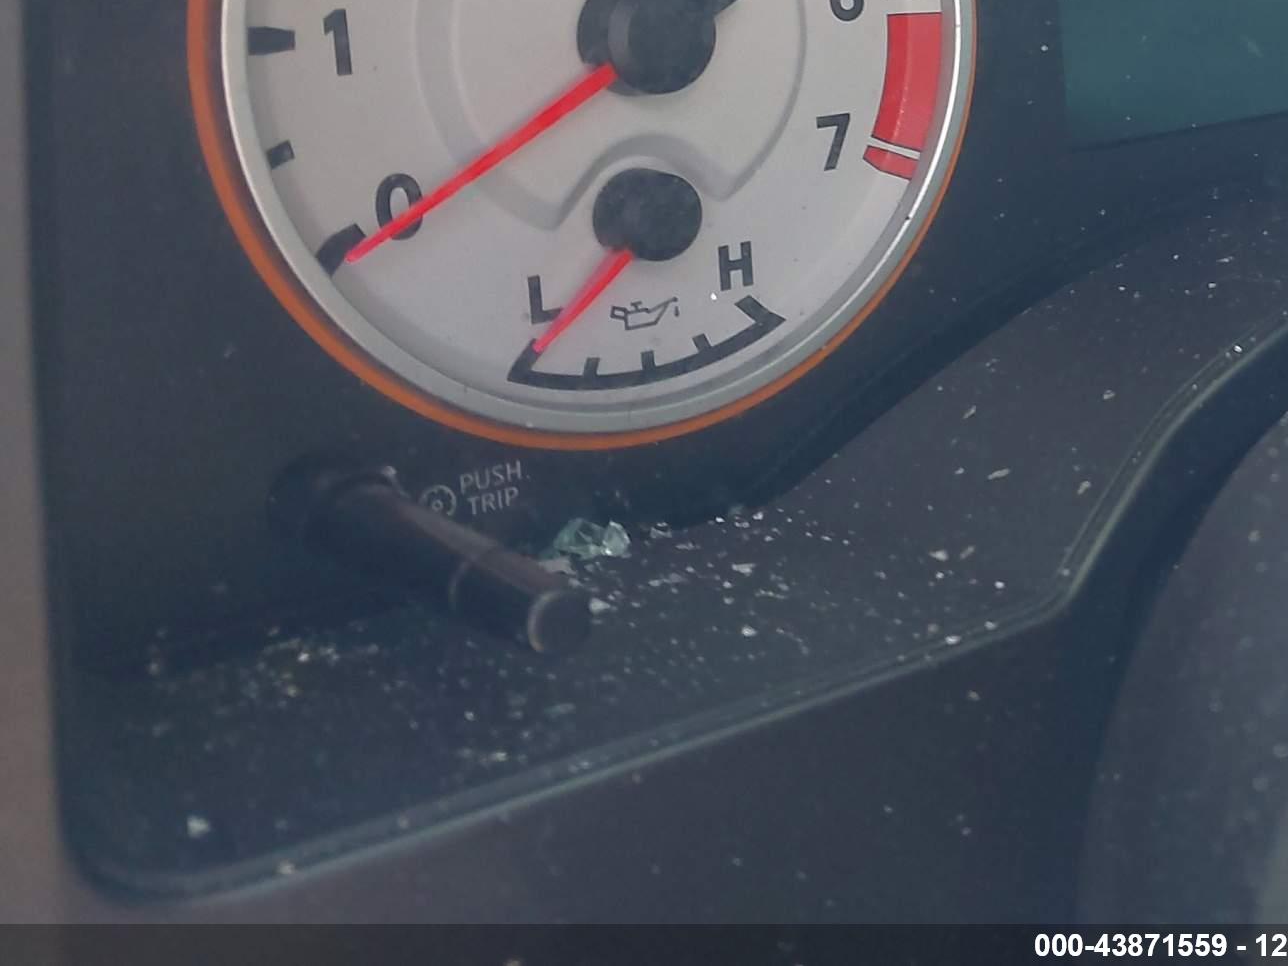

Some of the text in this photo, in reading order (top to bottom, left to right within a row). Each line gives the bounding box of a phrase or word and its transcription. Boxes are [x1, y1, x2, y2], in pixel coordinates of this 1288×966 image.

[323, 8, 353, 75] 1
[816, 113, 852, 171] 7
[375, 173, 423, 240] 0
[717, 240, 753, 291] H
[527, 275, 561, 324] L
[460, 460, 521, 494] PUSH
[467, 487, 519, 515] TRIP
